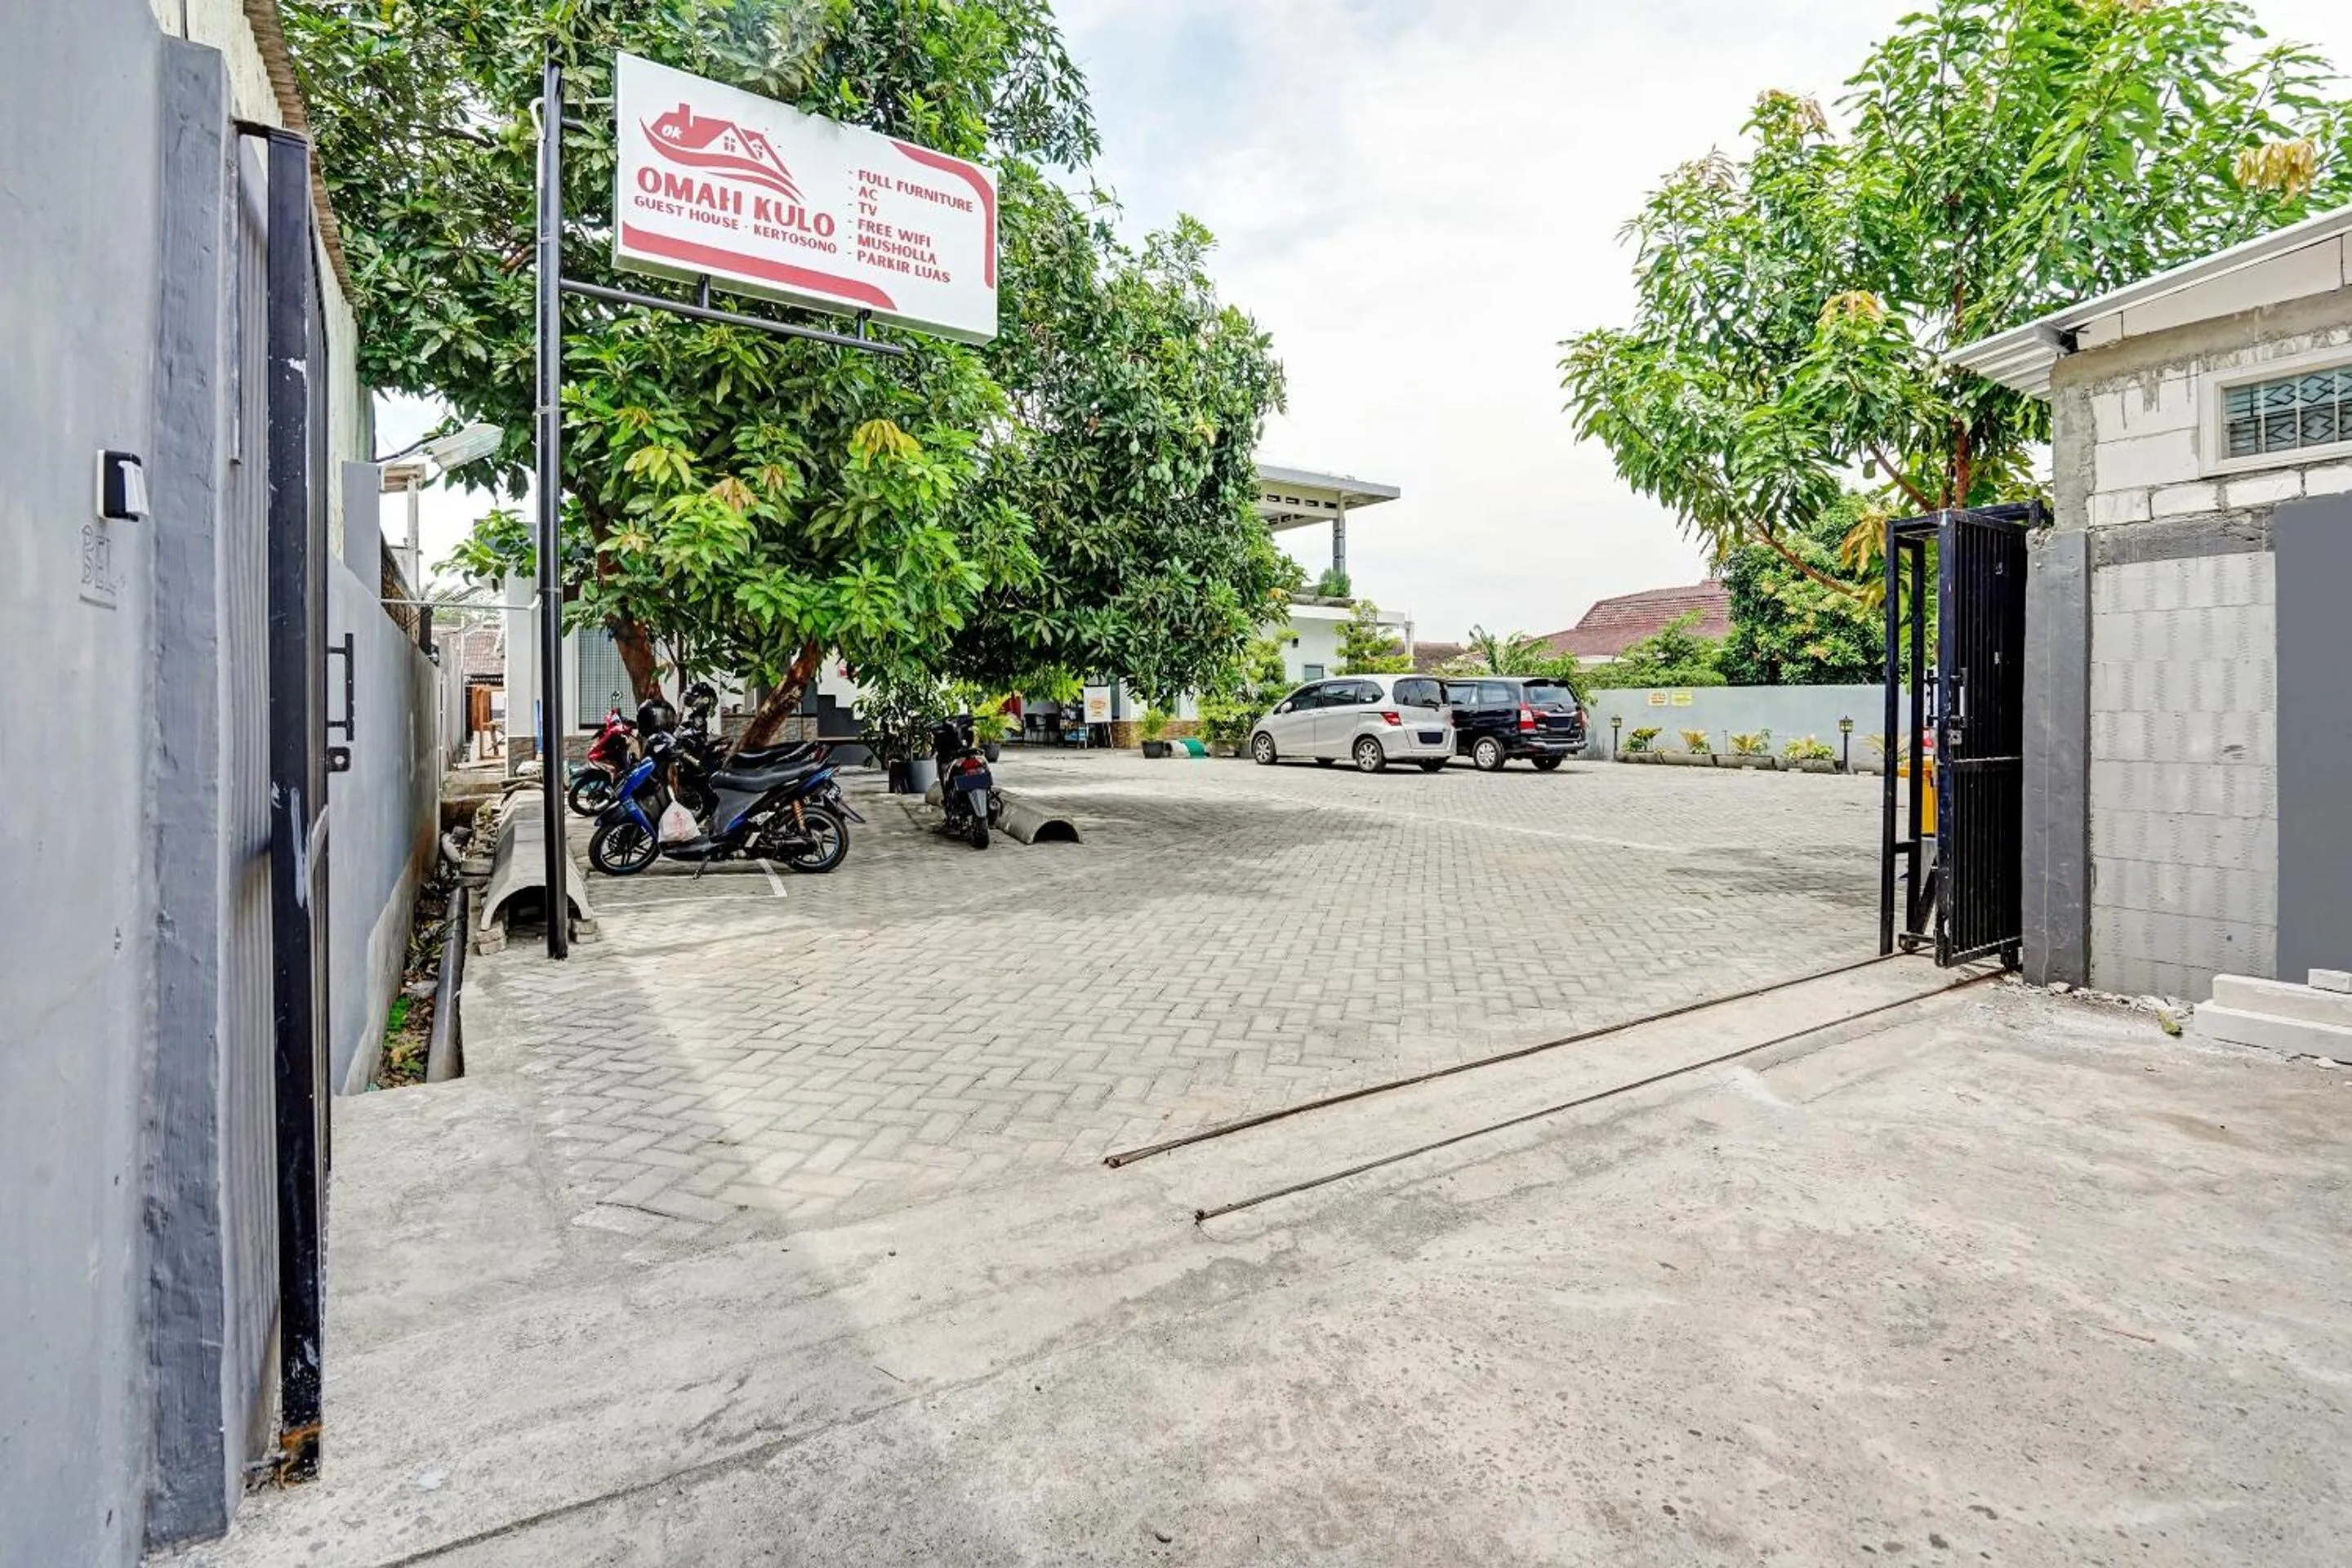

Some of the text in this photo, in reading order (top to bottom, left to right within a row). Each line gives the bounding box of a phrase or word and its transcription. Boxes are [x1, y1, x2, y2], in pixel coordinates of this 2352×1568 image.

[637, 167, 835, 237] OMAH KULO
[858, 169, 973, 212] FULL FURNITURE
[858, 186, 879, 202] AC
[635, 195, 684, 216] GUEST
[689, 209, 739, 230] HOUSE
[754, 224, 837, 254] KERTOSONO
[858, 202, 878, 217] TV
[858, 218, 931, 247] FREE WIFI
[858, 234, 937, 265] MUSHOLLA
[858, 250, 951, 283] PARKIR LUAS
